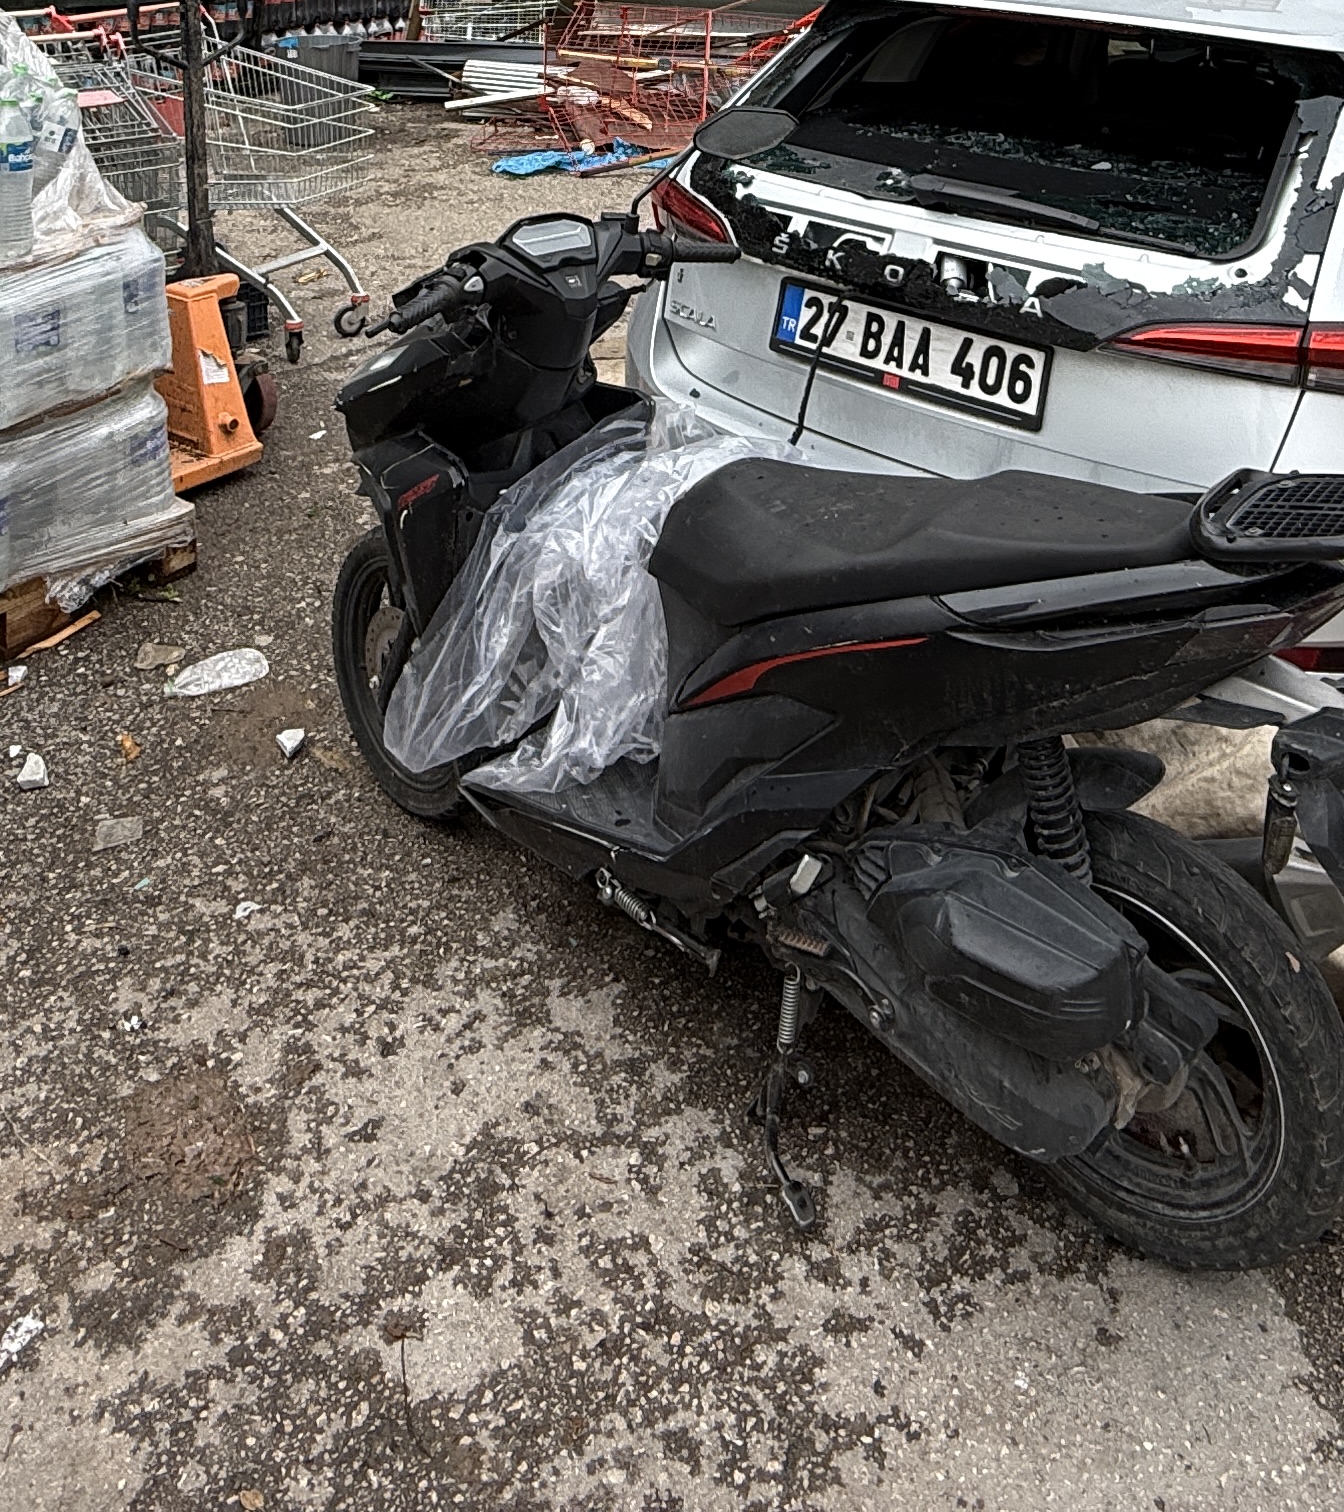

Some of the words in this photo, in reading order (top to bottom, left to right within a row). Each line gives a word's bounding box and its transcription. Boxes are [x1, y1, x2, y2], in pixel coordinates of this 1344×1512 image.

[670, 299, 717, 331] SCALA
[782, 315, 797, 334] TR
[859, 313, 932, 377] BAA
[950, 336, 1036, 405] 406
